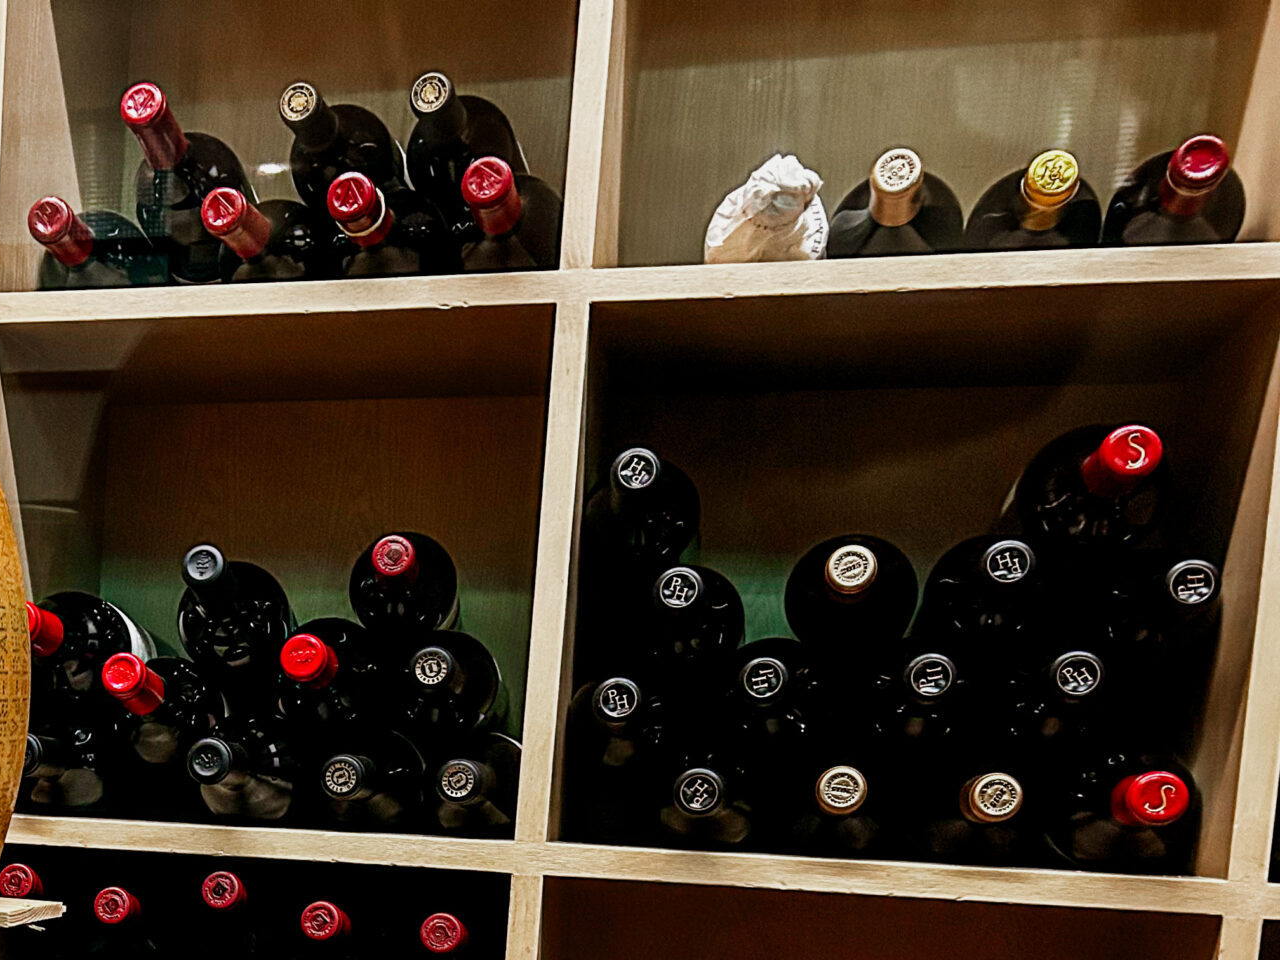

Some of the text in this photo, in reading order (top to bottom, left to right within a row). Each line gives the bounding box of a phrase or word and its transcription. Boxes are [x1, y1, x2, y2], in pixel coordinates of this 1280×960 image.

[1125, 432, 1147, 470] S
[839, 561, 862, 576] 2015
[1143, 784, 1176, 814] S
